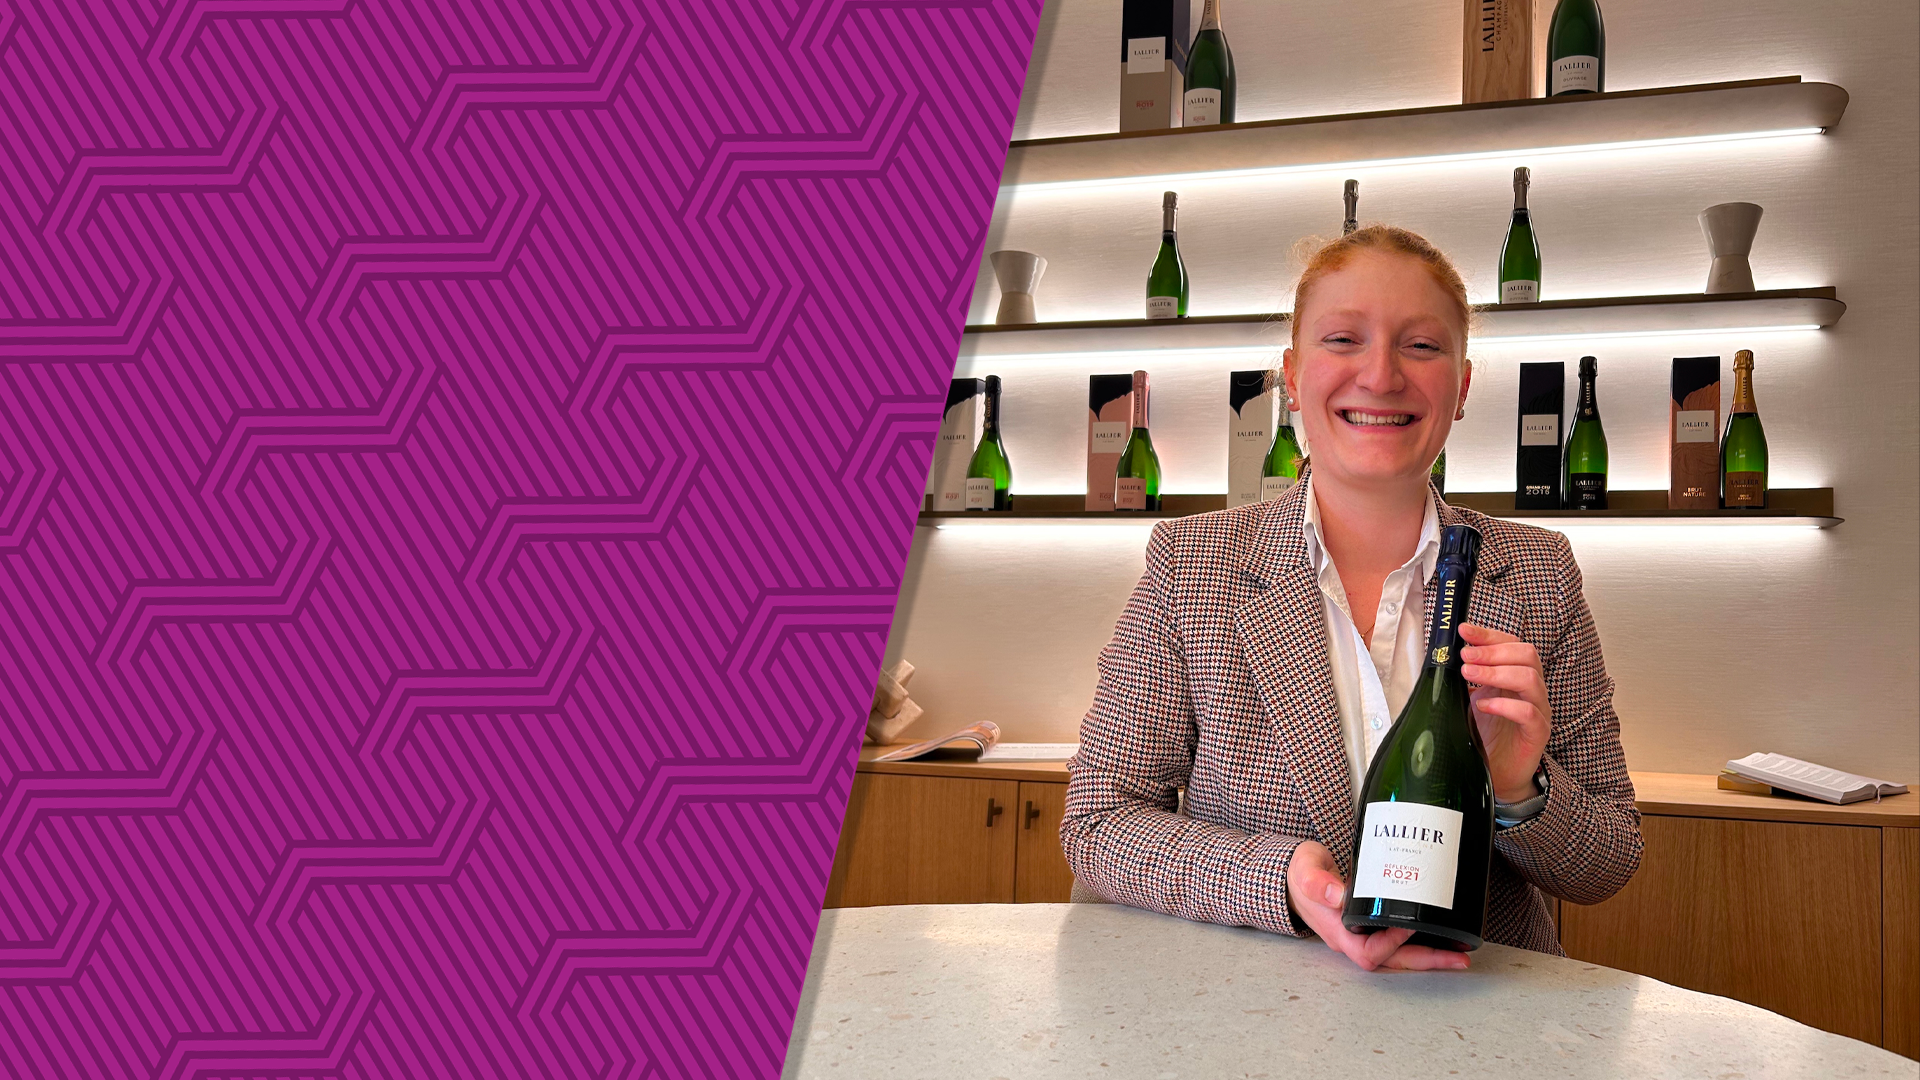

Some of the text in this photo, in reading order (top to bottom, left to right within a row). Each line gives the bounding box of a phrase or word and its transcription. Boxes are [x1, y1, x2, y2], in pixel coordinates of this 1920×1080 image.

[1559, 62, 1592, 72] LALLIER
[1187, 97, 1215, 106] LALLIER
[1439, 579, 1457, 630] LALLIER
[1374, 824, 1444, 845] LALLIER
